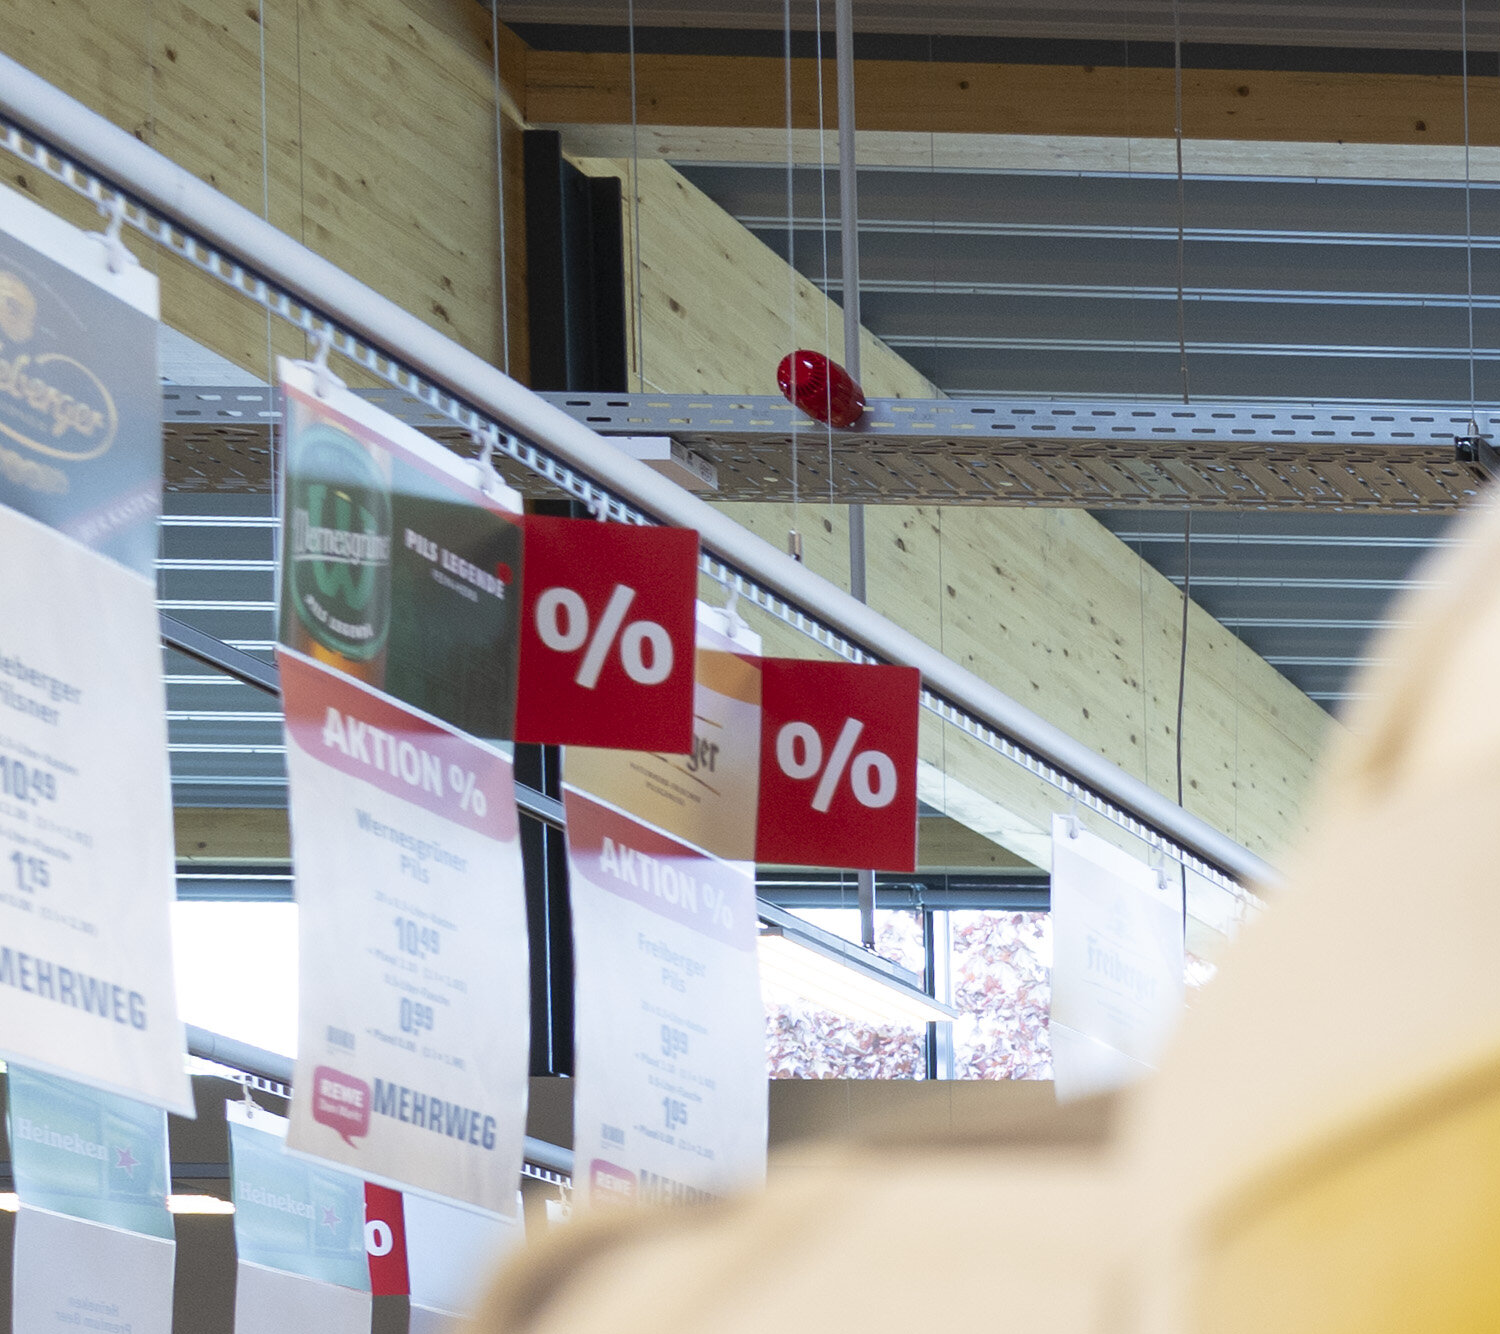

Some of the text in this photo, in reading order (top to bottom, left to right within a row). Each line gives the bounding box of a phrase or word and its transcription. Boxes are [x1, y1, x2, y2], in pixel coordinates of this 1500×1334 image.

[535, 583, 674, 690] %
[323, 706, 487, 818] AKTION %
[775, 716, 898, 814] %
[400, 854, 429, 884] Pils
[600, 836, 698, 914] AKTION
[0, 945, 147, 1030] MEHRWEG
[638, 932, 706, 978] Freiberger
[319, 1079, 364, 1108] REWE
[373, 1076, 496, 1150] MEHRWEG
[15, 1117, 109, 1162] Heineken
[239, 1181, 316, 1220] Heineken
